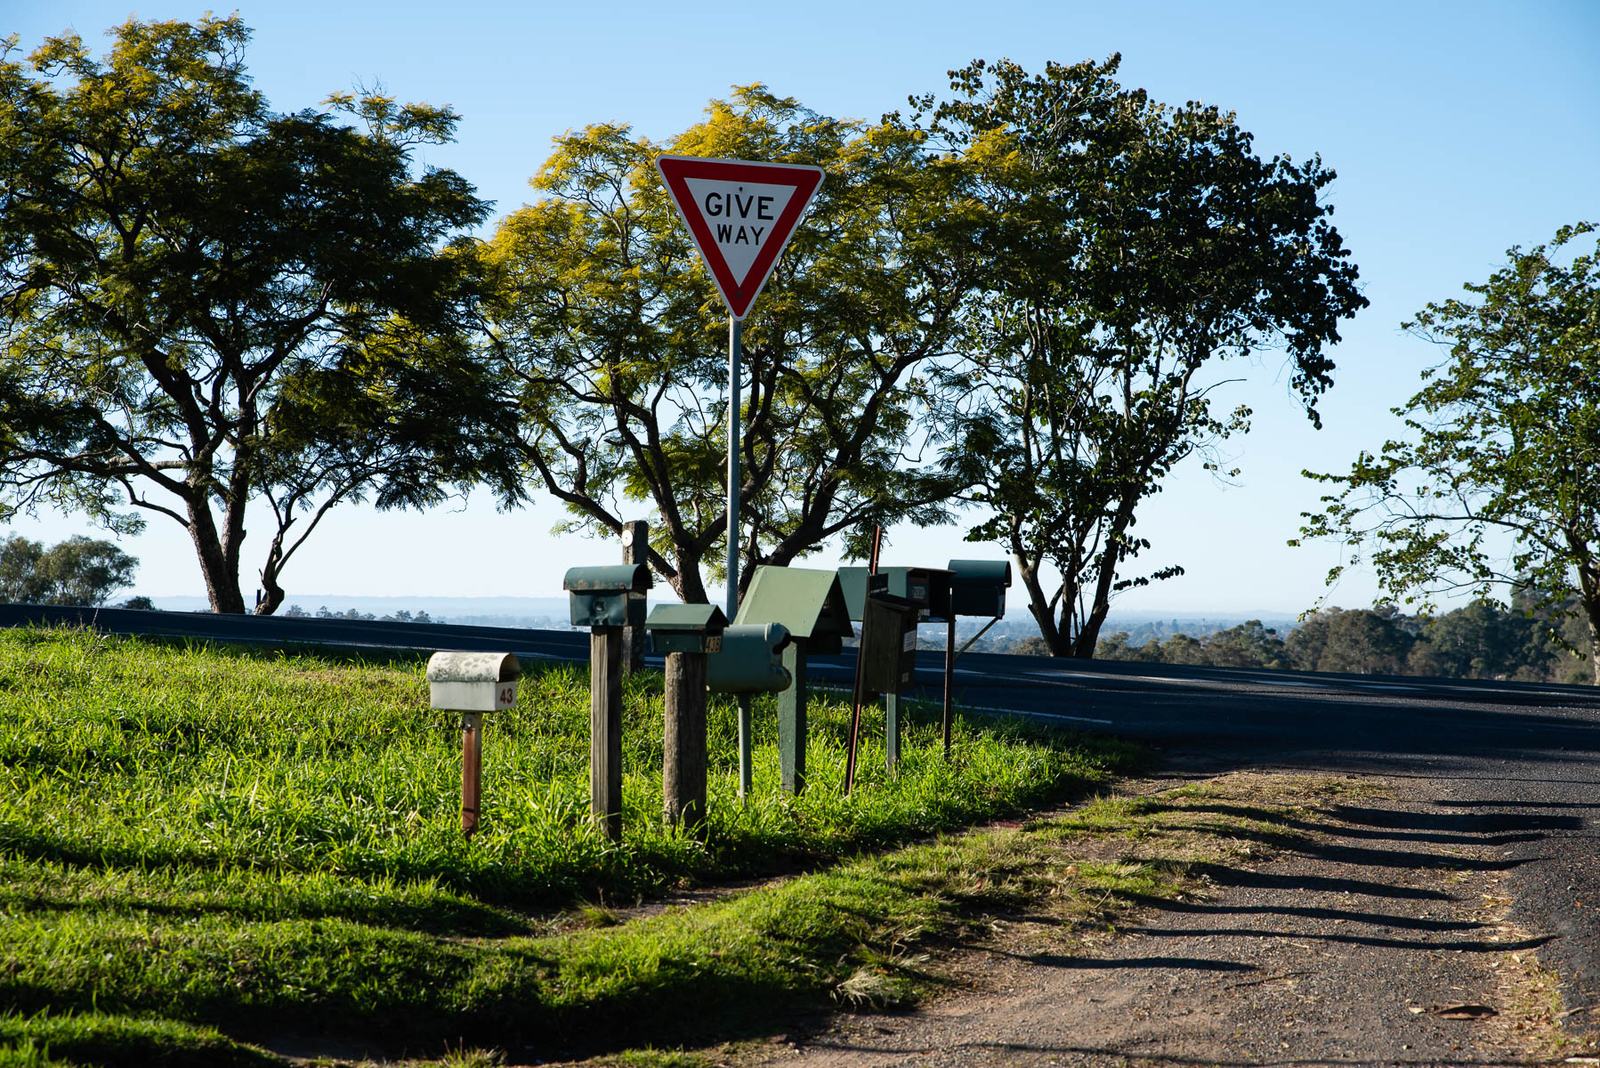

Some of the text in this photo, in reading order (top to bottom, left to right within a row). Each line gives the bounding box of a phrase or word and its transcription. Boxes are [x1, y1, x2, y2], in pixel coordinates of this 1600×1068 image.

[705, 192, 774, 220] GIVE
[717, 224, 764, 245] WAY
[500, 688, 513, 704] 43
